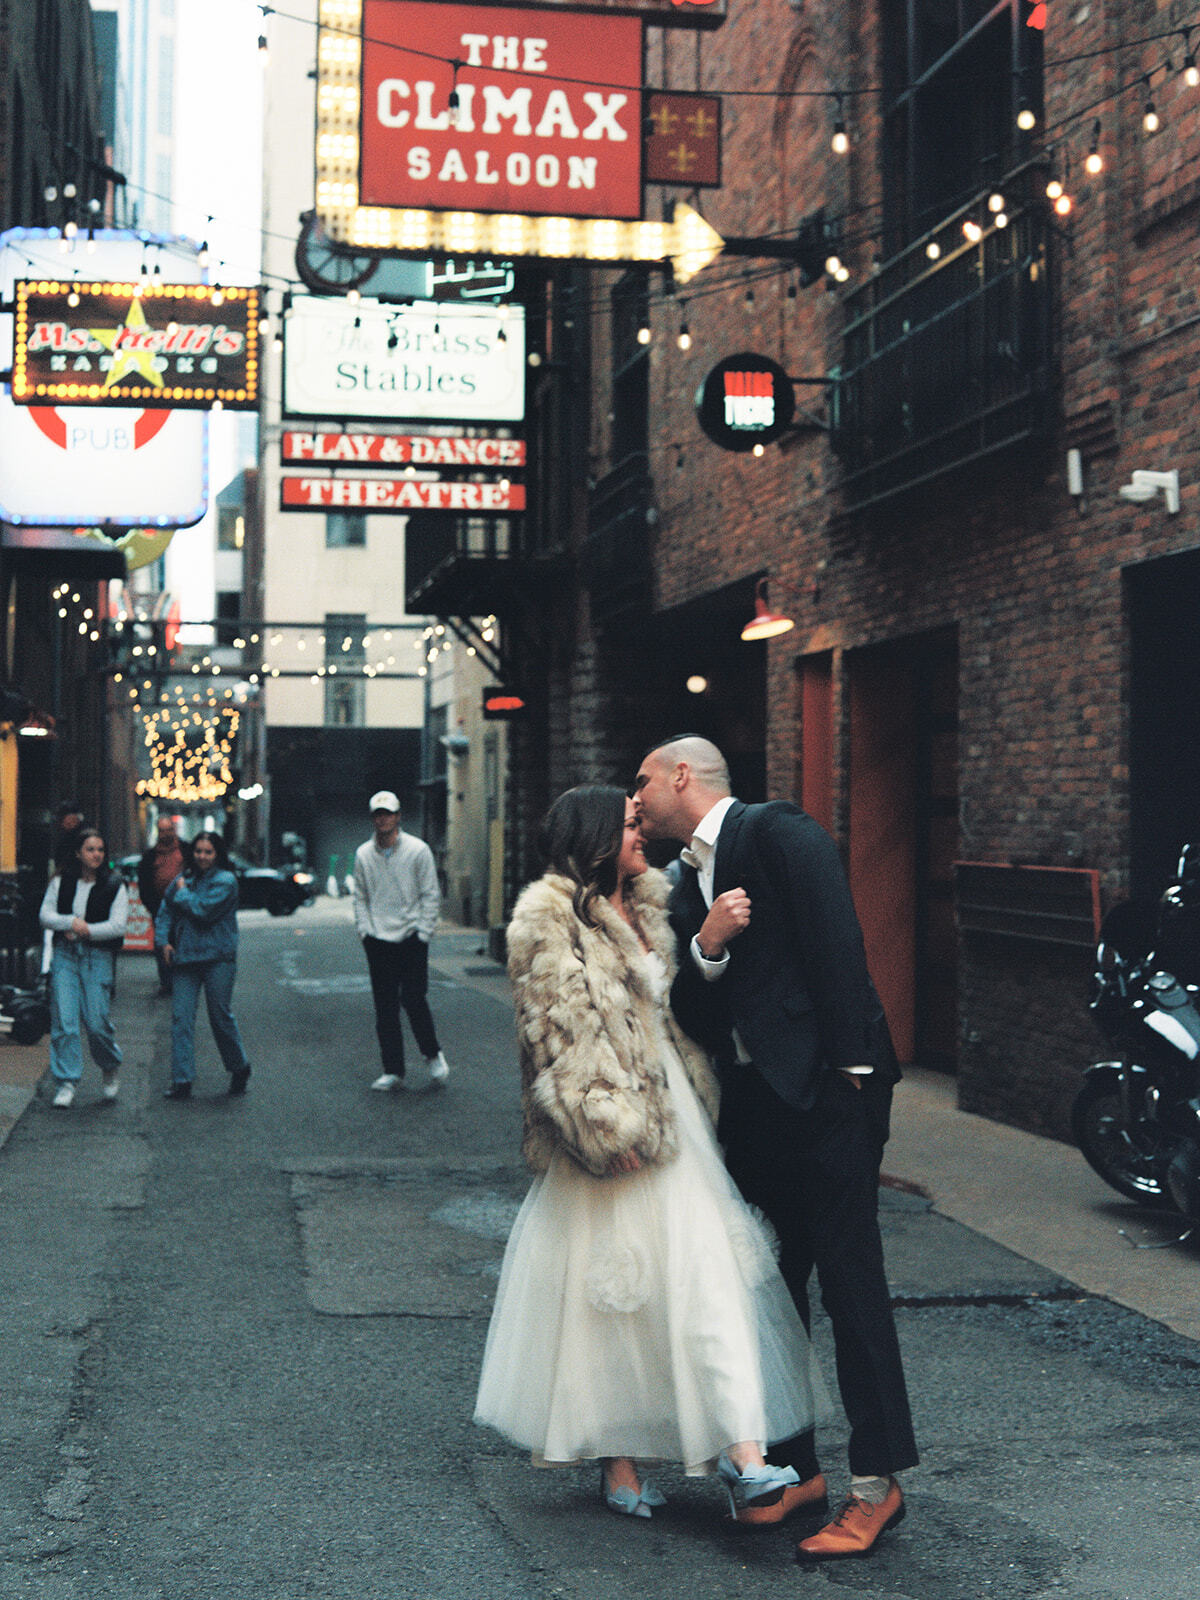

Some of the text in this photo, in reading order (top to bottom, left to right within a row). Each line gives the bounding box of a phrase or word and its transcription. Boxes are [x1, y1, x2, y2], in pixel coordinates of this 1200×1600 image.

[461, 33, 549, 72] THE
[377, 78, 628, 142] CLIMAX
[407, 146, 598, 190] SALOON
[27, 322, 105, 353] Ms.
[387, 325, 491, 355] Brass
[51, 354, 218, 374] KARAOKE
[336, 361, 477, 395] Stables
[72, 427, 130, 450] PUB
[291, 432, 522, 466] PLAY & DANCE
[301, 478, 511, 510] THEATRE
